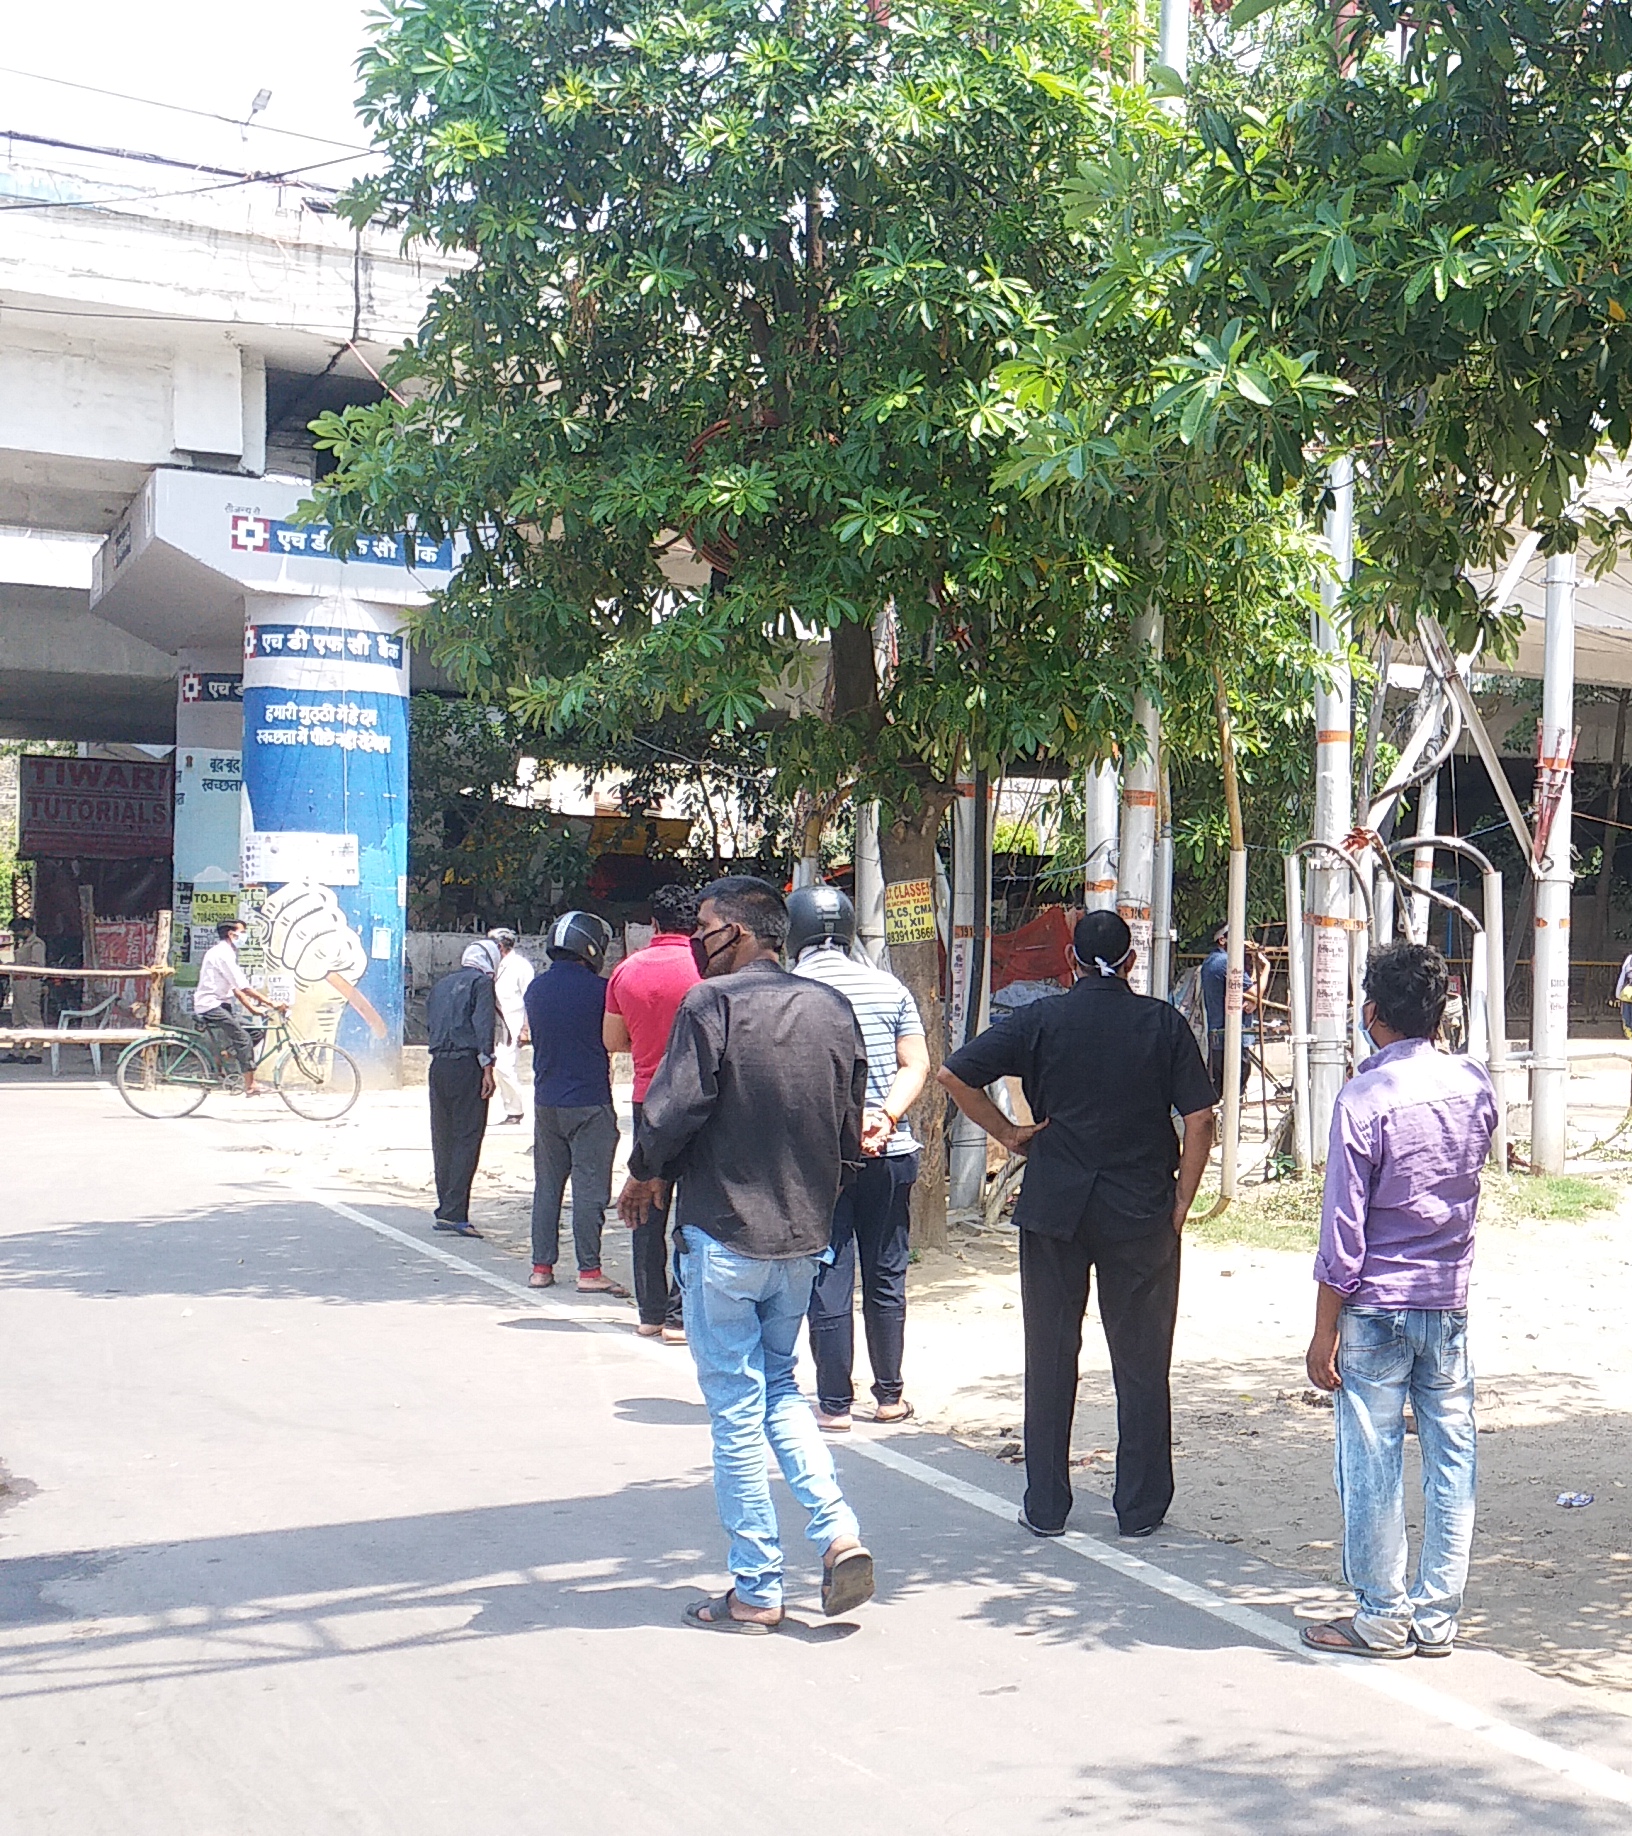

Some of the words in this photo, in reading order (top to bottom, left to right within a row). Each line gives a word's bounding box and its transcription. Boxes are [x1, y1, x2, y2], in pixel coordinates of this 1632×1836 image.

[276, 529, 307, 552] एच
[261, 633, 284, 653] एच
[287, 628, 311, 651] डी
[312, 633, 344, 655] एफ
[347, 634, 371, 656] सी
[376, 632, 399, 660] बैंक
[208, 681, 233, 697] एच
[28, 760, 168, 790] TIWARI
[201, 778, 243, 793] स्वच्छता
[27, 797, 167, 825] TUTORIALS
[194, 893, 237, 904] TO-LET
[909, 916, 925, 927] XII
